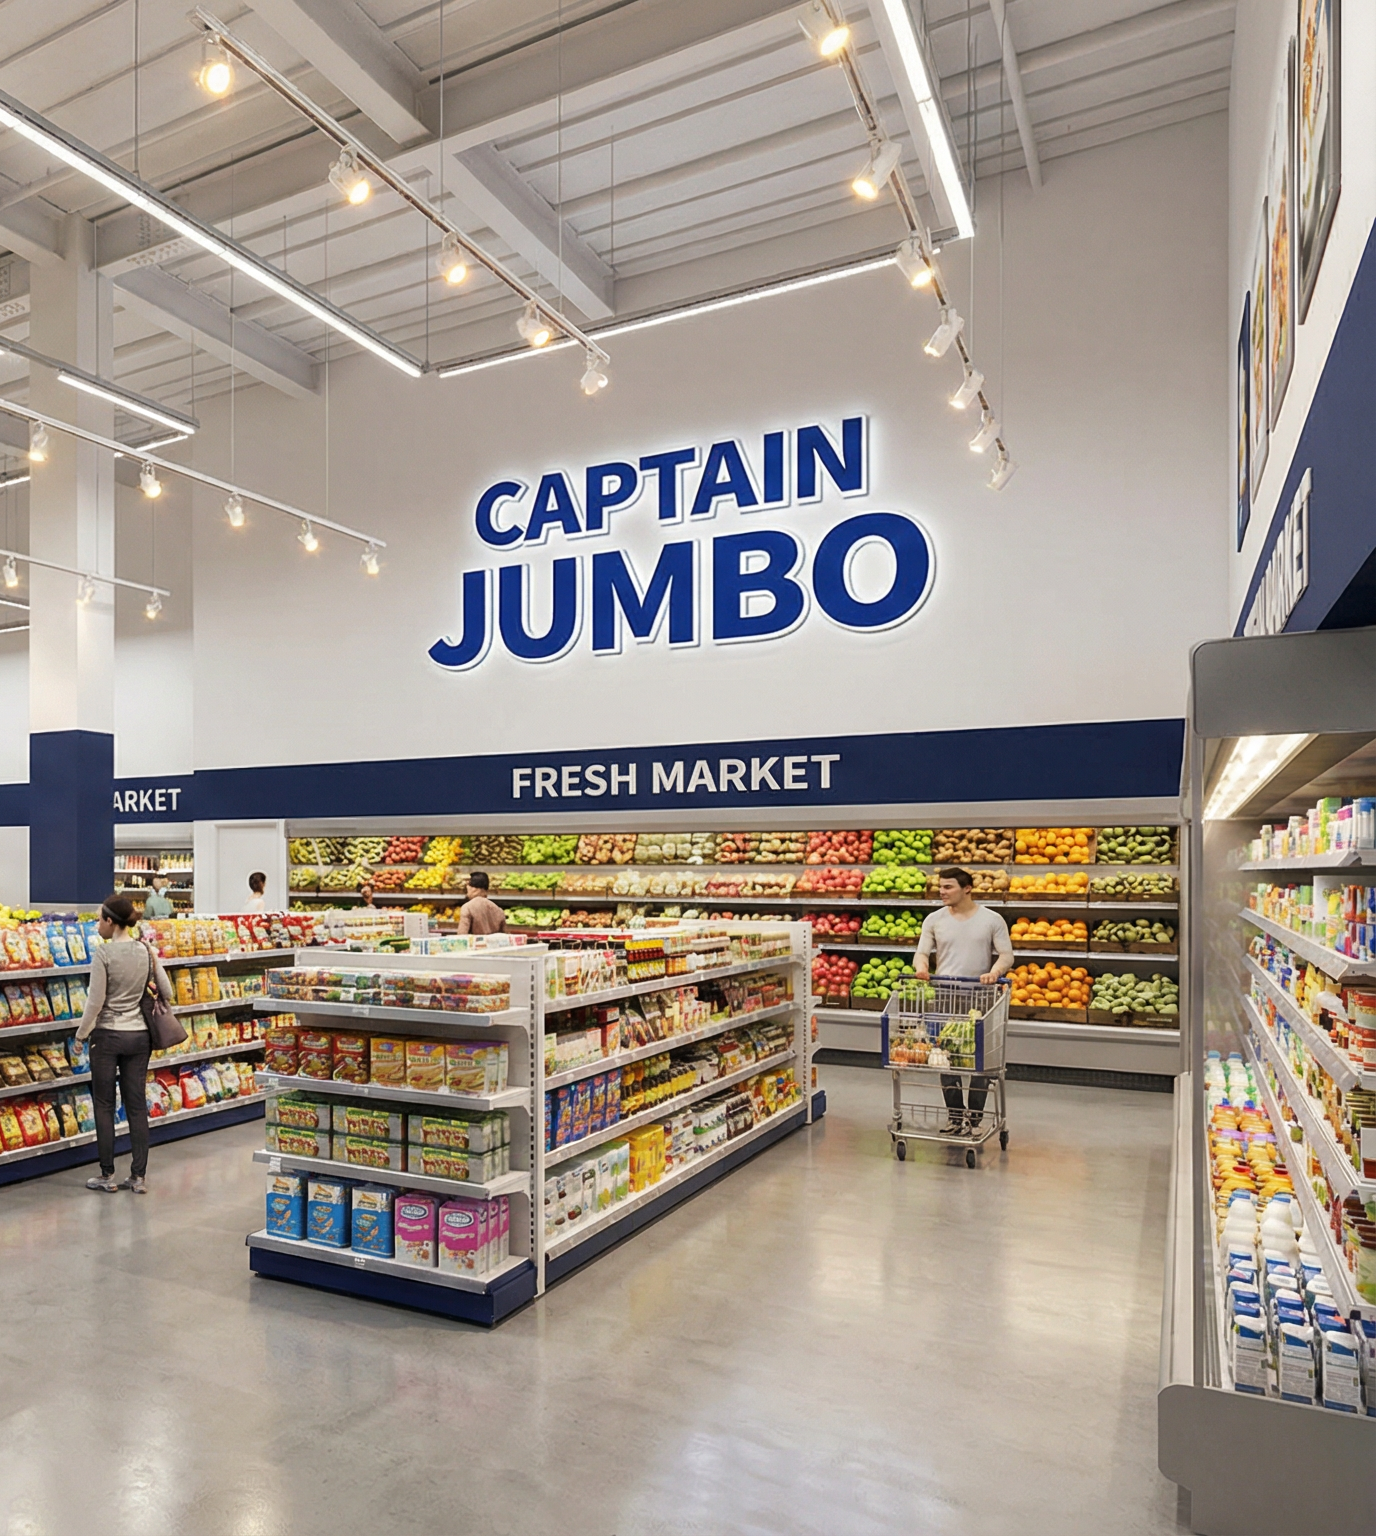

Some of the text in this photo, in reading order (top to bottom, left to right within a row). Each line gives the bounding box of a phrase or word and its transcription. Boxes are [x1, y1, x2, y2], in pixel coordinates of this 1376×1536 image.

[474, 415, 867, 548] CAPTAIN
[427, 512, 932, 668] JUMBO
[512, 754, 841, 798] FRESH MARKET
